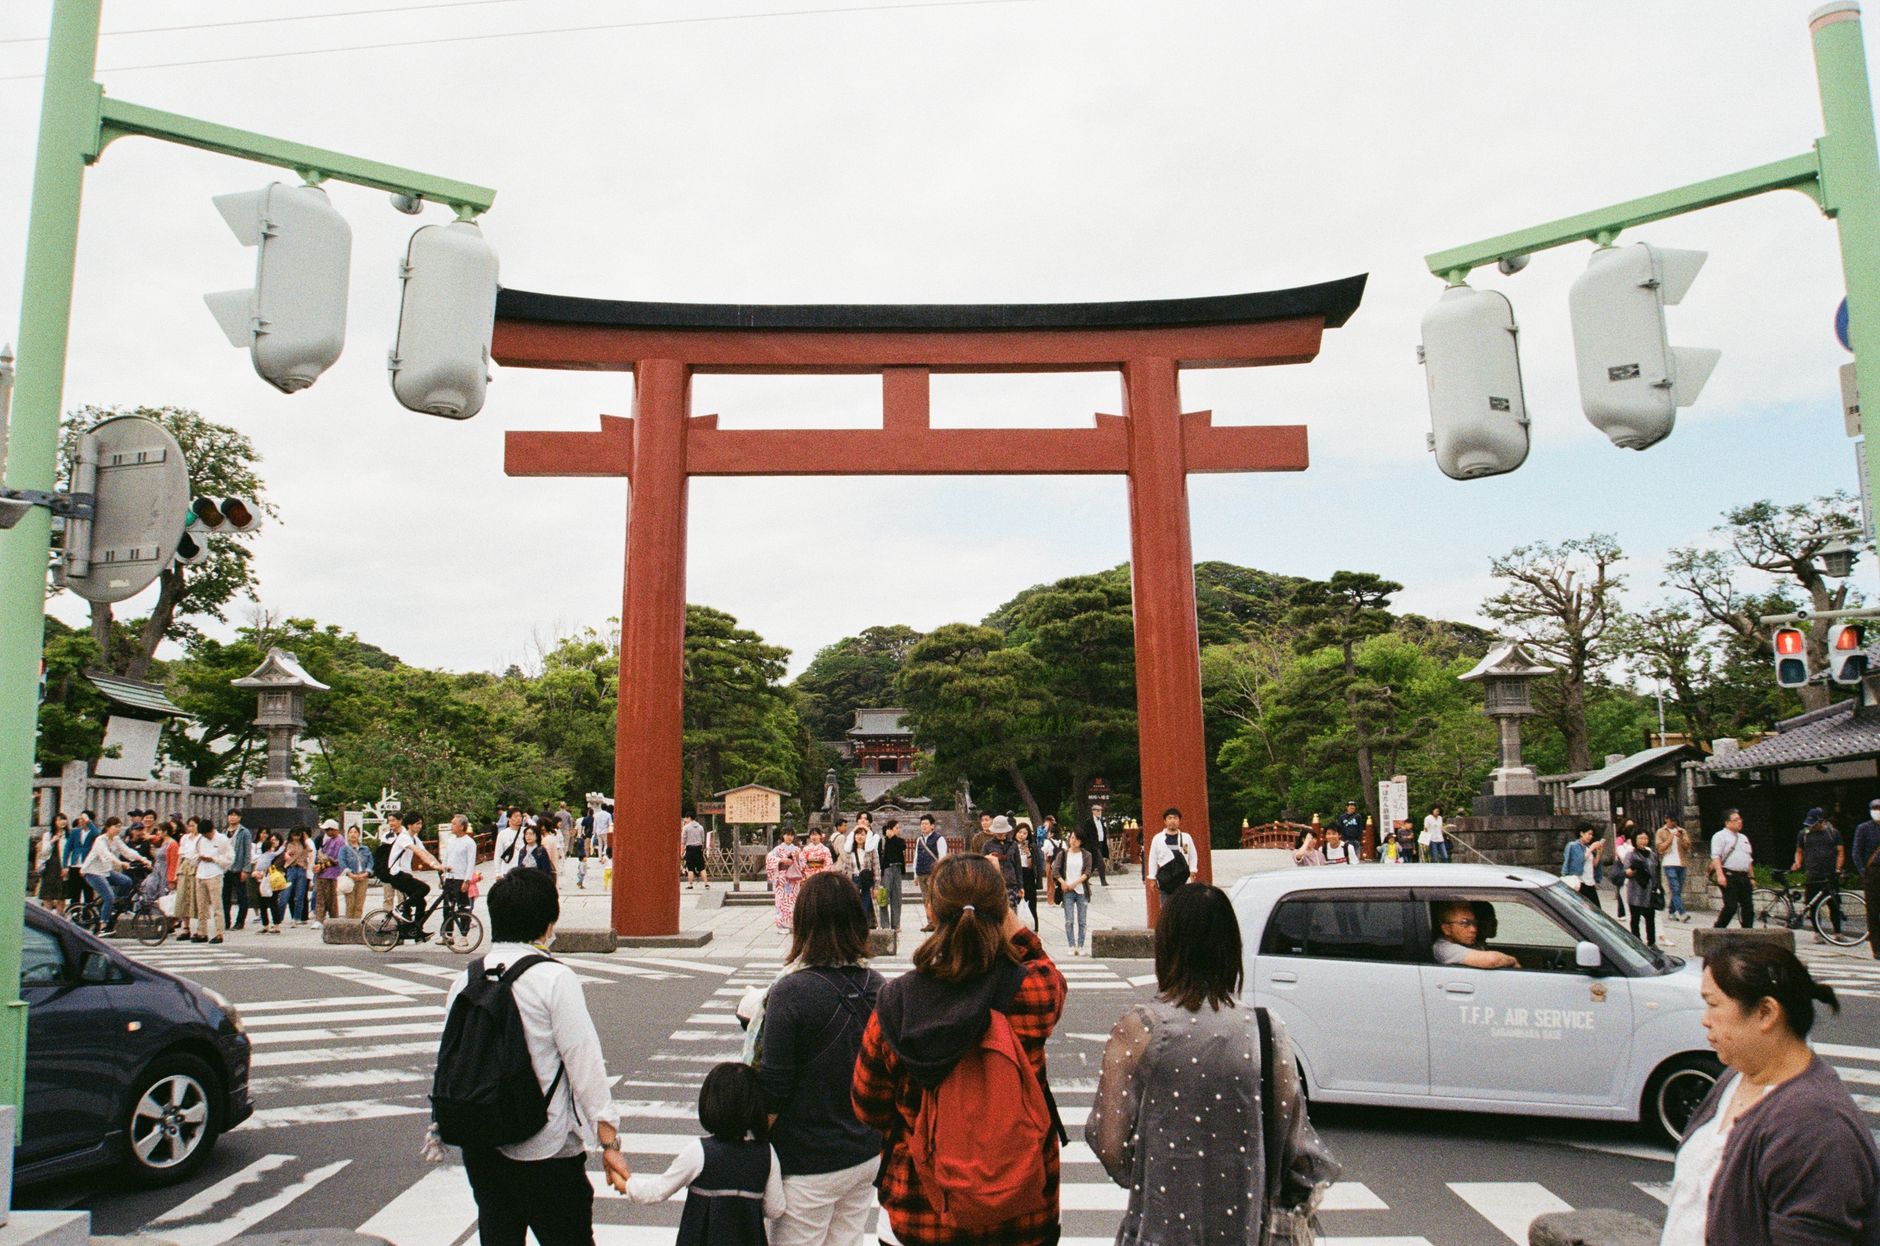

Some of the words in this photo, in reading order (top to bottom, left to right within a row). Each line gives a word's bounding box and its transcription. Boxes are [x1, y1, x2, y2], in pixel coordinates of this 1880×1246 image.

[1458, 1005, 1498, 1026] T.F.P.
[1505, 1008, 1529, 1026] AIR
[1534, 1009, 1595, 1030] SERVICE
